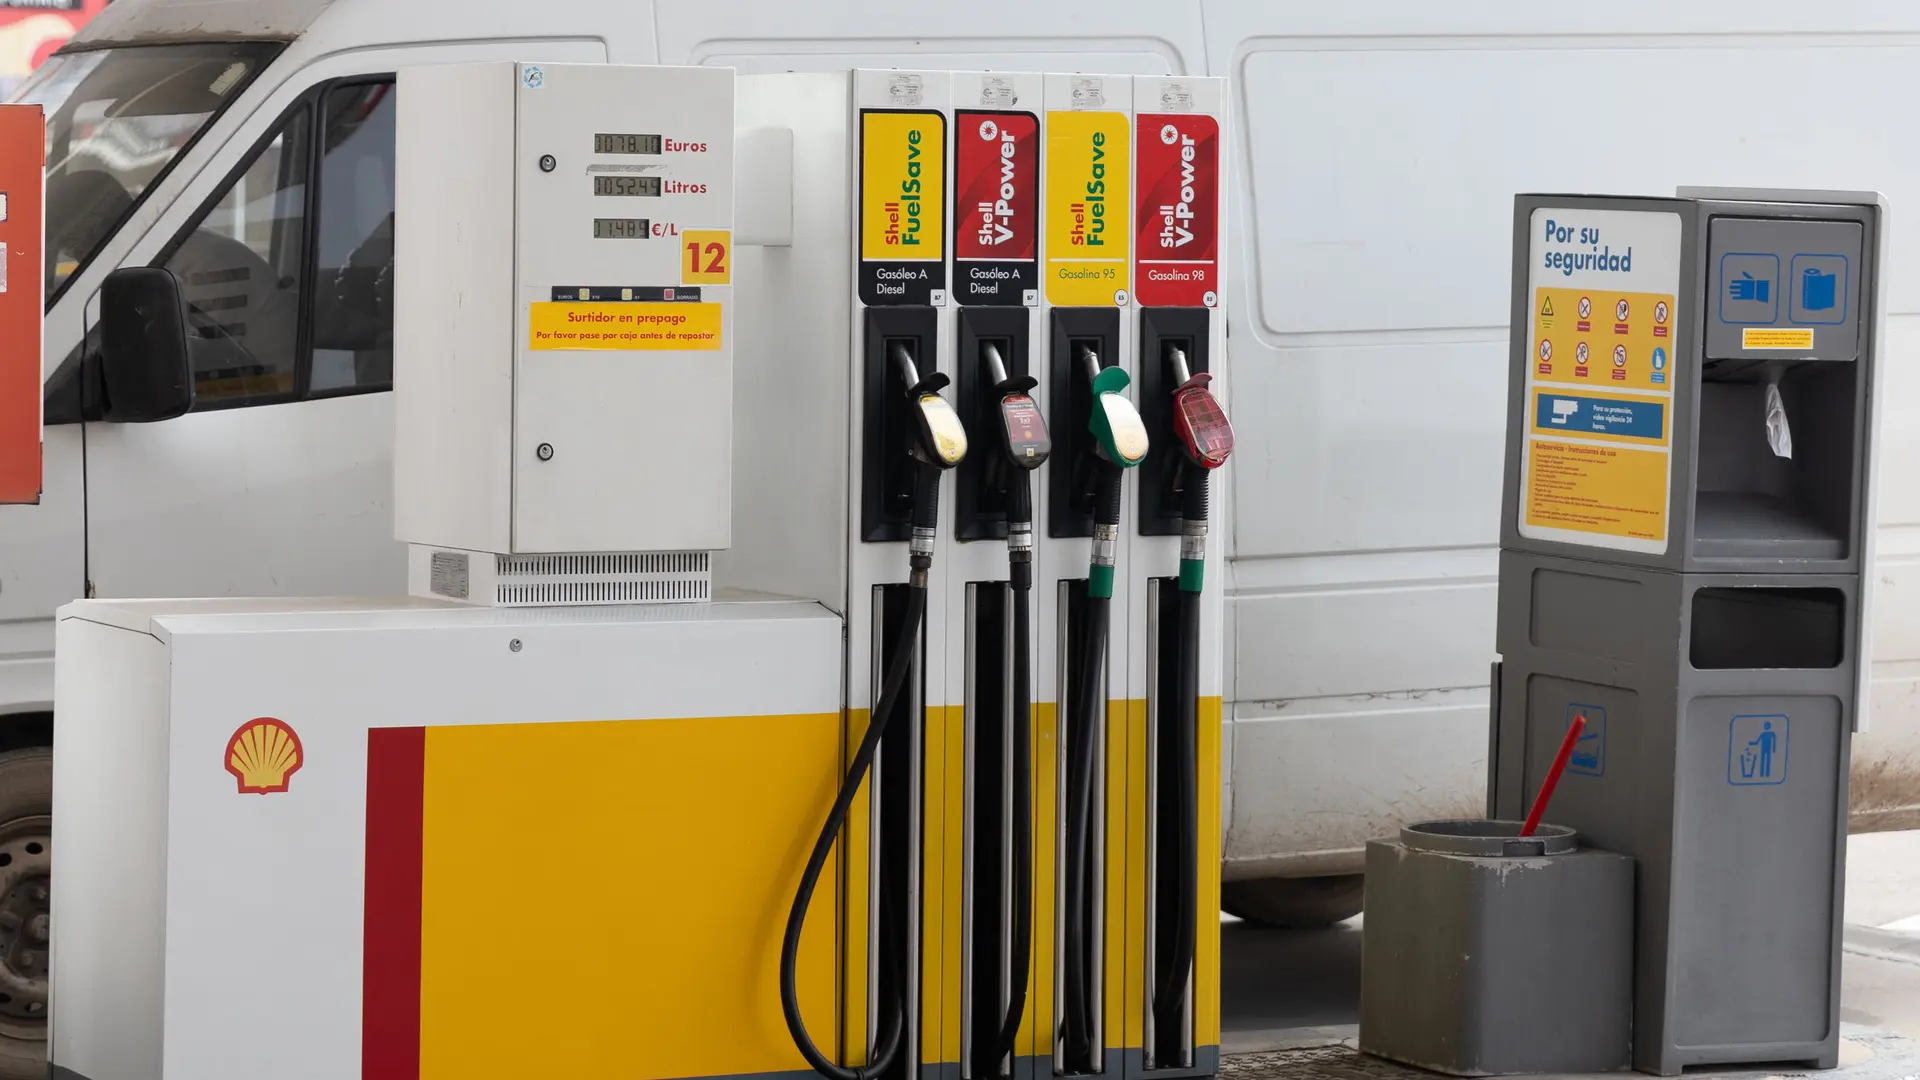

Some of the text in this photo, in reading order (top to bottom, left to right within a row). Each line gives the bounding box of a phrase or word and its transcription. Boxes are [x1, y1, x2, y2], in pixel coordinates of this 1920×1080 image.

[665, 138, 707, 152] Euros
[664, 180, 707, 194] Litros
[901, 129, 921, 245] FuelSave
[994, 130, 1015, 245] V-Power
[1086, 132, 1105, 246] FuelSave
[1175, 133, 1195, 248] V-Power
[651, 223, 678, 237] €/L
[885, 202, 899, 245] Shell
[978, 202, 993, 245] Shell
[1070, 203, 1084, 245] Shell
[1160, 205, 1174, 248] Shell
[1545, 219, 1599, 244] Por su
[687, 242, 725, 273] 12
[1544, 245, 1632, 276] seguridad
[876, 267, 928, 280] Gasóleo A
[970, 267, 1020, 280] Gasóleo A
[1059, 268, 1116, 279] Gasolina 95
[1148, 269, 1205, 281] Gasolina 98
[876, 282, 906, 295] Diesel
[970, 282, 998, 294] Diesel
[568, 312, 686, 325] Surtidor en prepago
[536, 331, 714, 341] Por favor pase por caja antes de repostar
[1592, 404, 1603, 412] Para
[1536, 441, 1564, 452] Autoservicio
[1600, 448, 1606, 456] de
